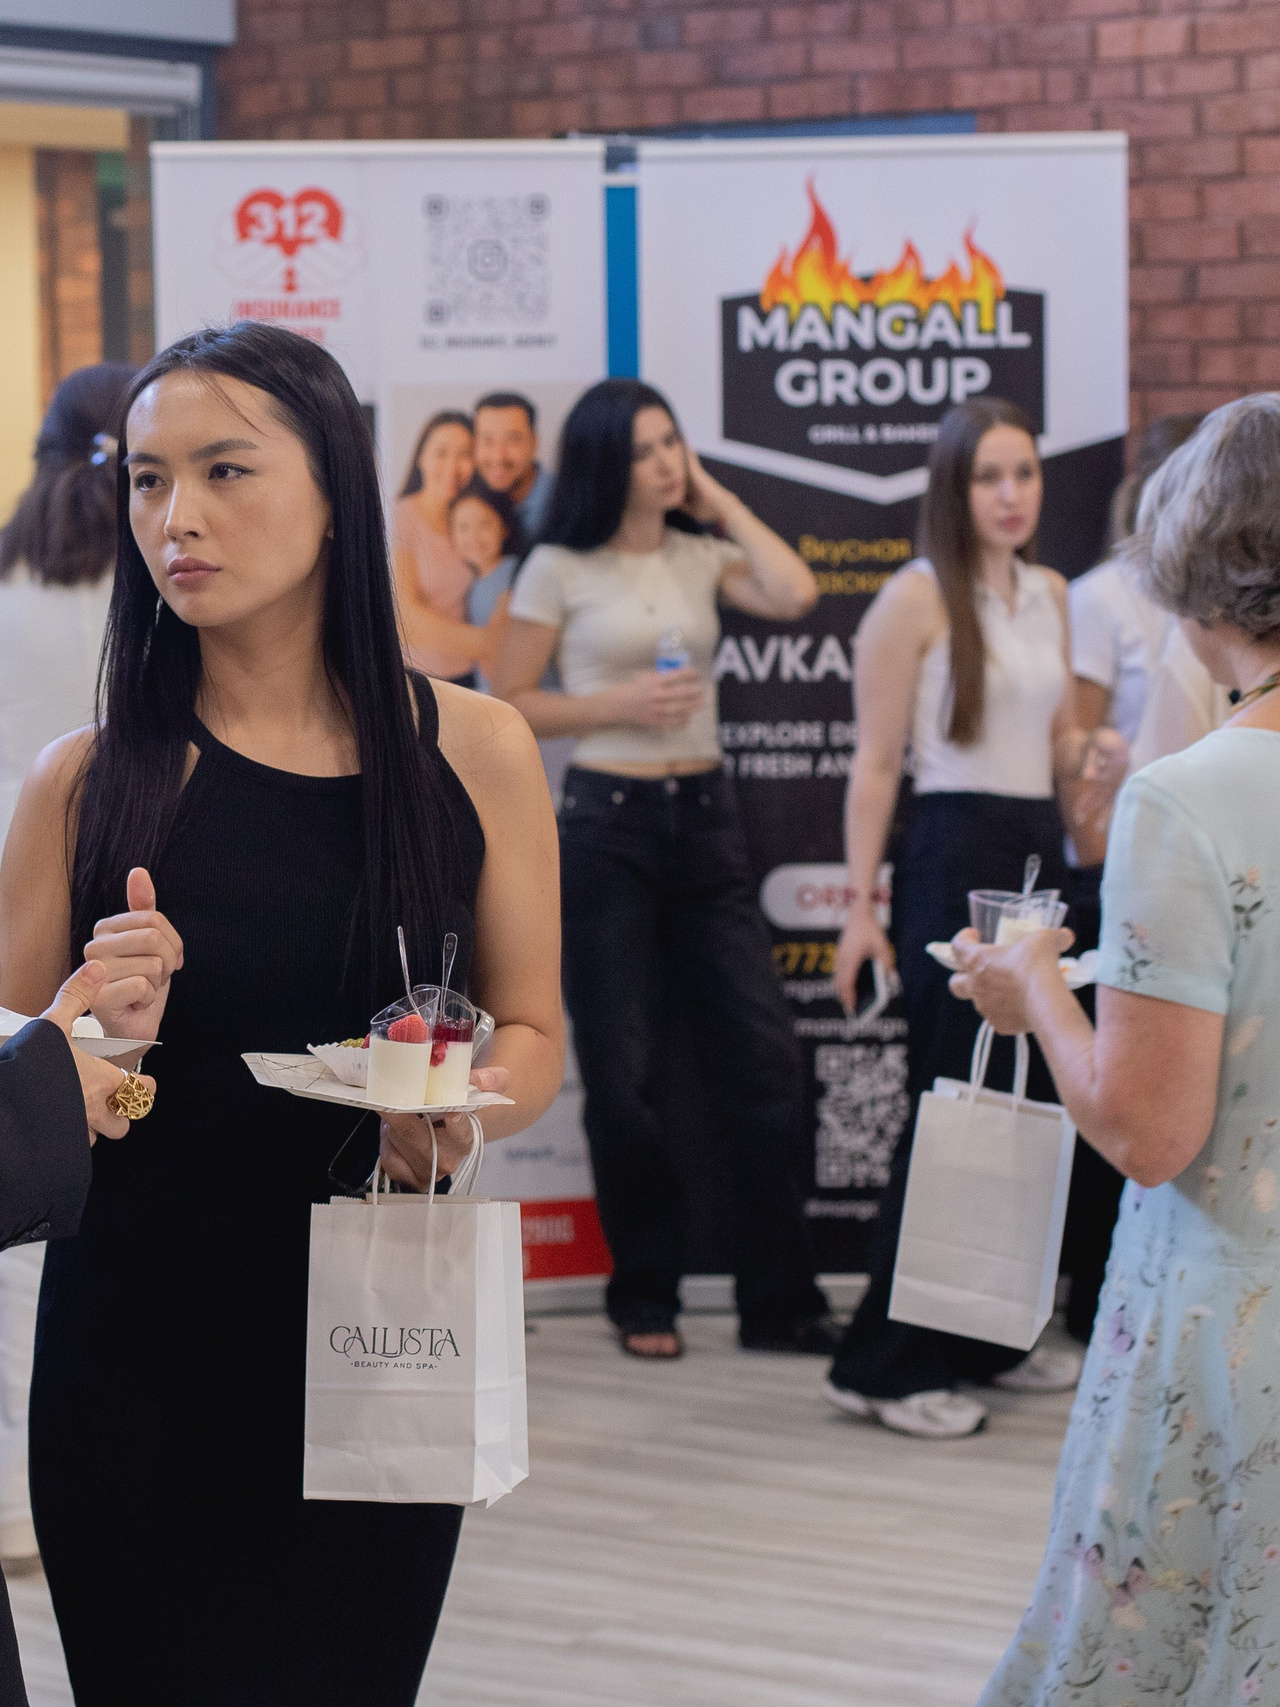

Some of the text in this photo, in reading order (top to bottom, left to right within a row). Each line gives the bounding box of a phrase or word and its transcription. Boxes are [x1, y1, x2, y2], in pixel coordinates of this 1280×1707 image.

[245, 200, 329, 240] 312
[738, 302, 1031, 351] MANGALL
[775, 358, 992, 407] GROUP
[808, 424, 861, 445] GRILL
[723, 722, 824, 747] EXPLORE
[739, 754, 812, 778] FRESH
[329, 1326, 461, 1361] CALLISTA
